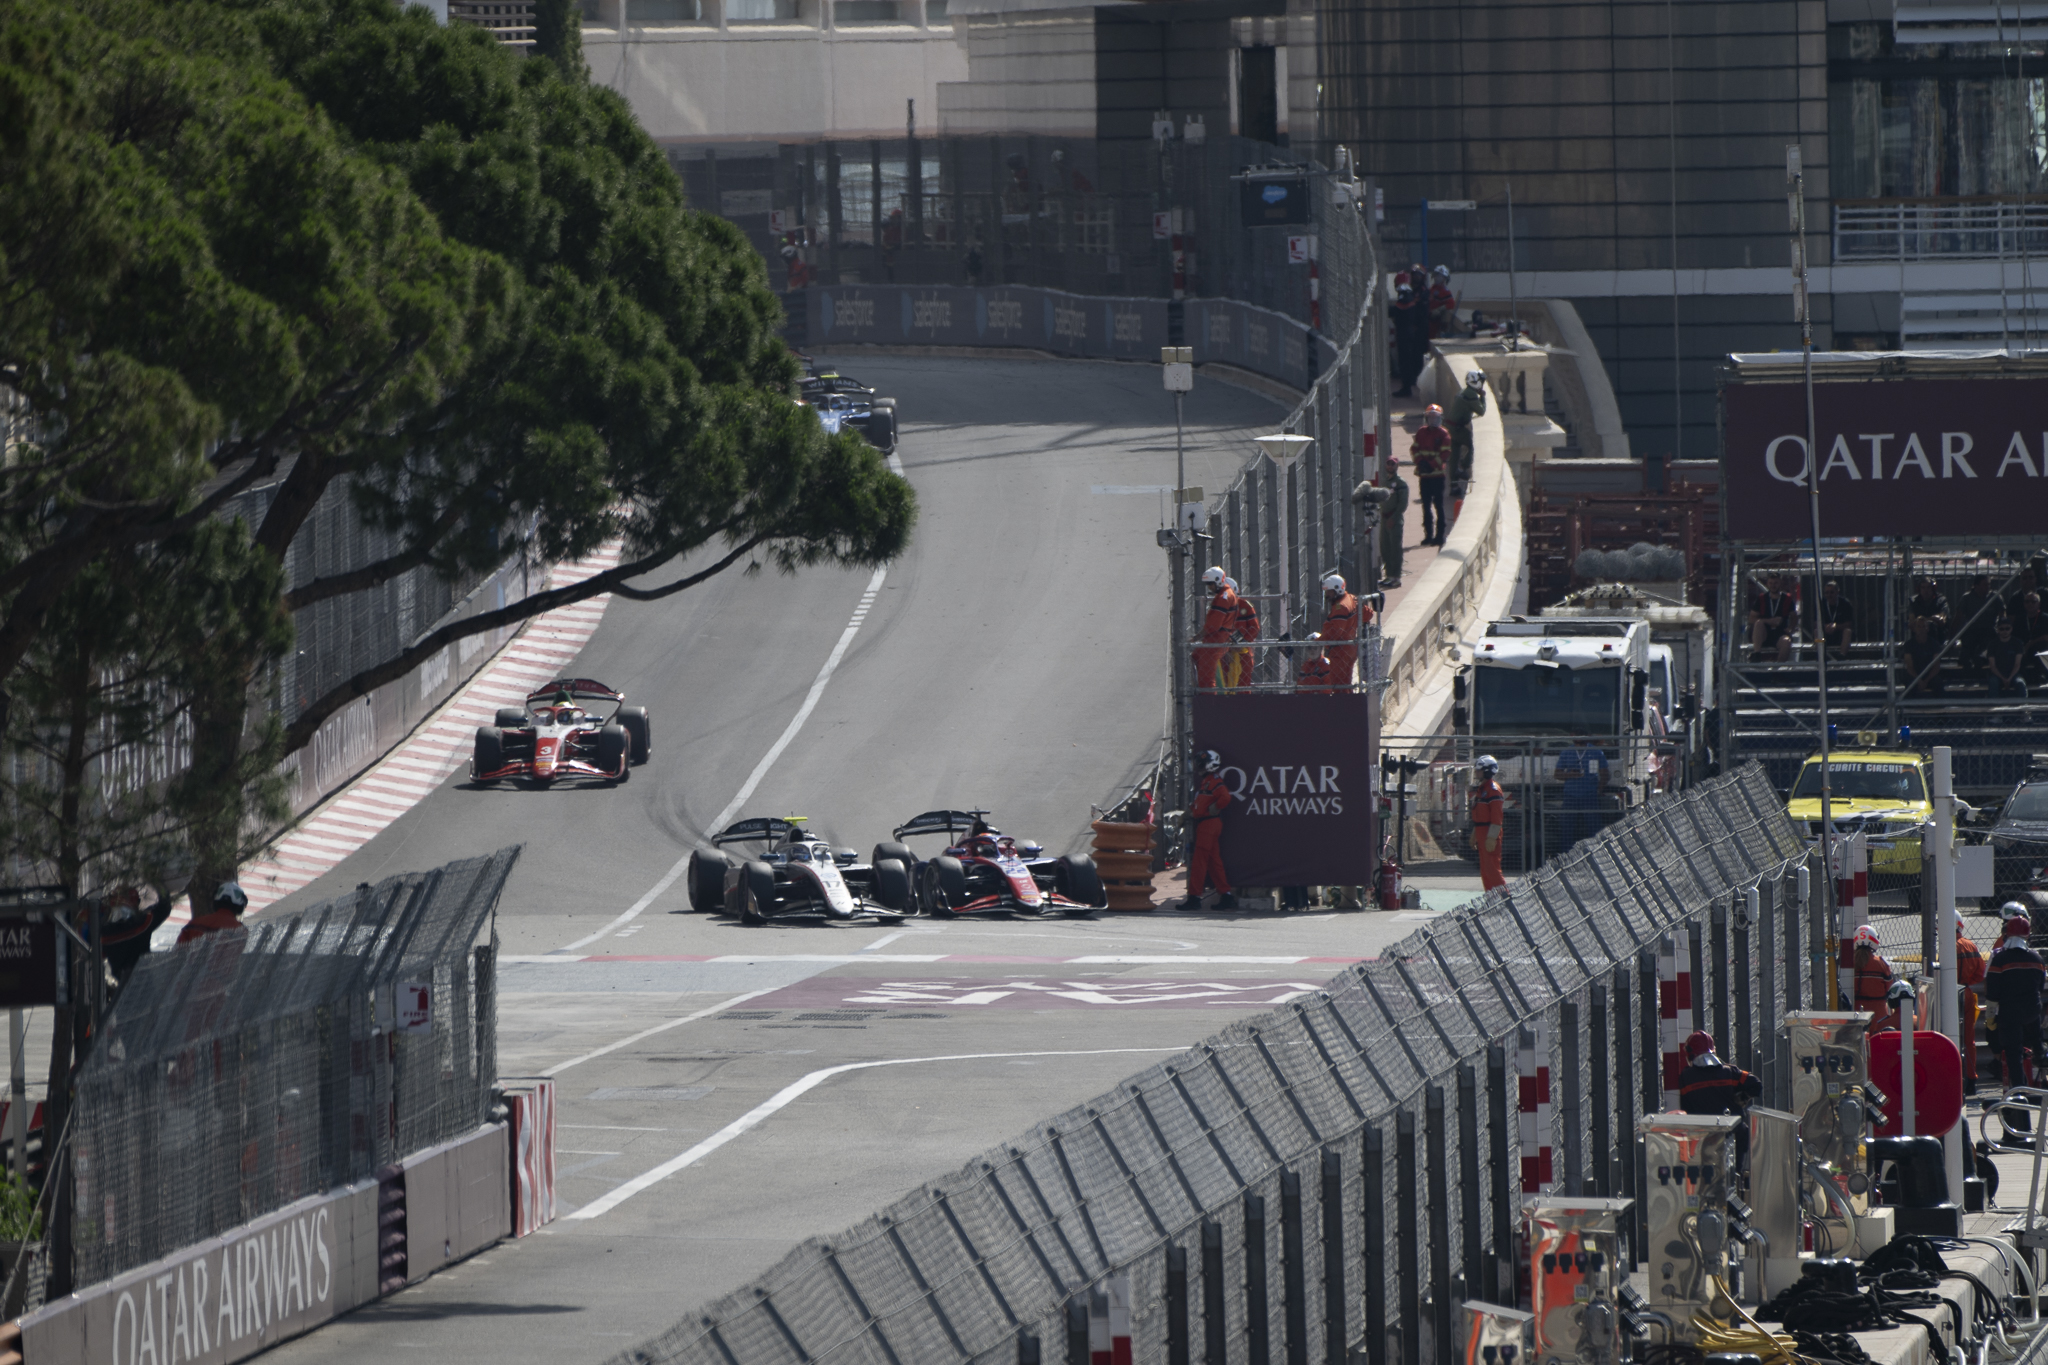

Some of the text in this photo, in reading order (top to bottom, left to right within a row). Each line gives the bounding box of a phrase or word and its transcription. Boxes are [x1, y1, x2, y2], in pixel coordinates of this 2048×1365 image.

[835, 290, 874, 336] salesforce
[914, 290, 951, 338] salesforce
[988, 290, 1022, 338] salesforce
[1055, 299, 1086, 347] salesforce
[808, 380, 857, 388] WILIAMS
[1765, 432, 1978, 486] QATAR
[540, 746, 552, 755] 3
[1220, 766, 1341, 801] QATAR
[1866, 764, 1903, 773] CIRCUIT
[1246, 797, 1343, 815] AIRWAYS
[822, 880, 840, 888] 17
[1859, 931, 1867, 940] S
[112, 1207, 331, 1365] QATAR AIRWAYS
